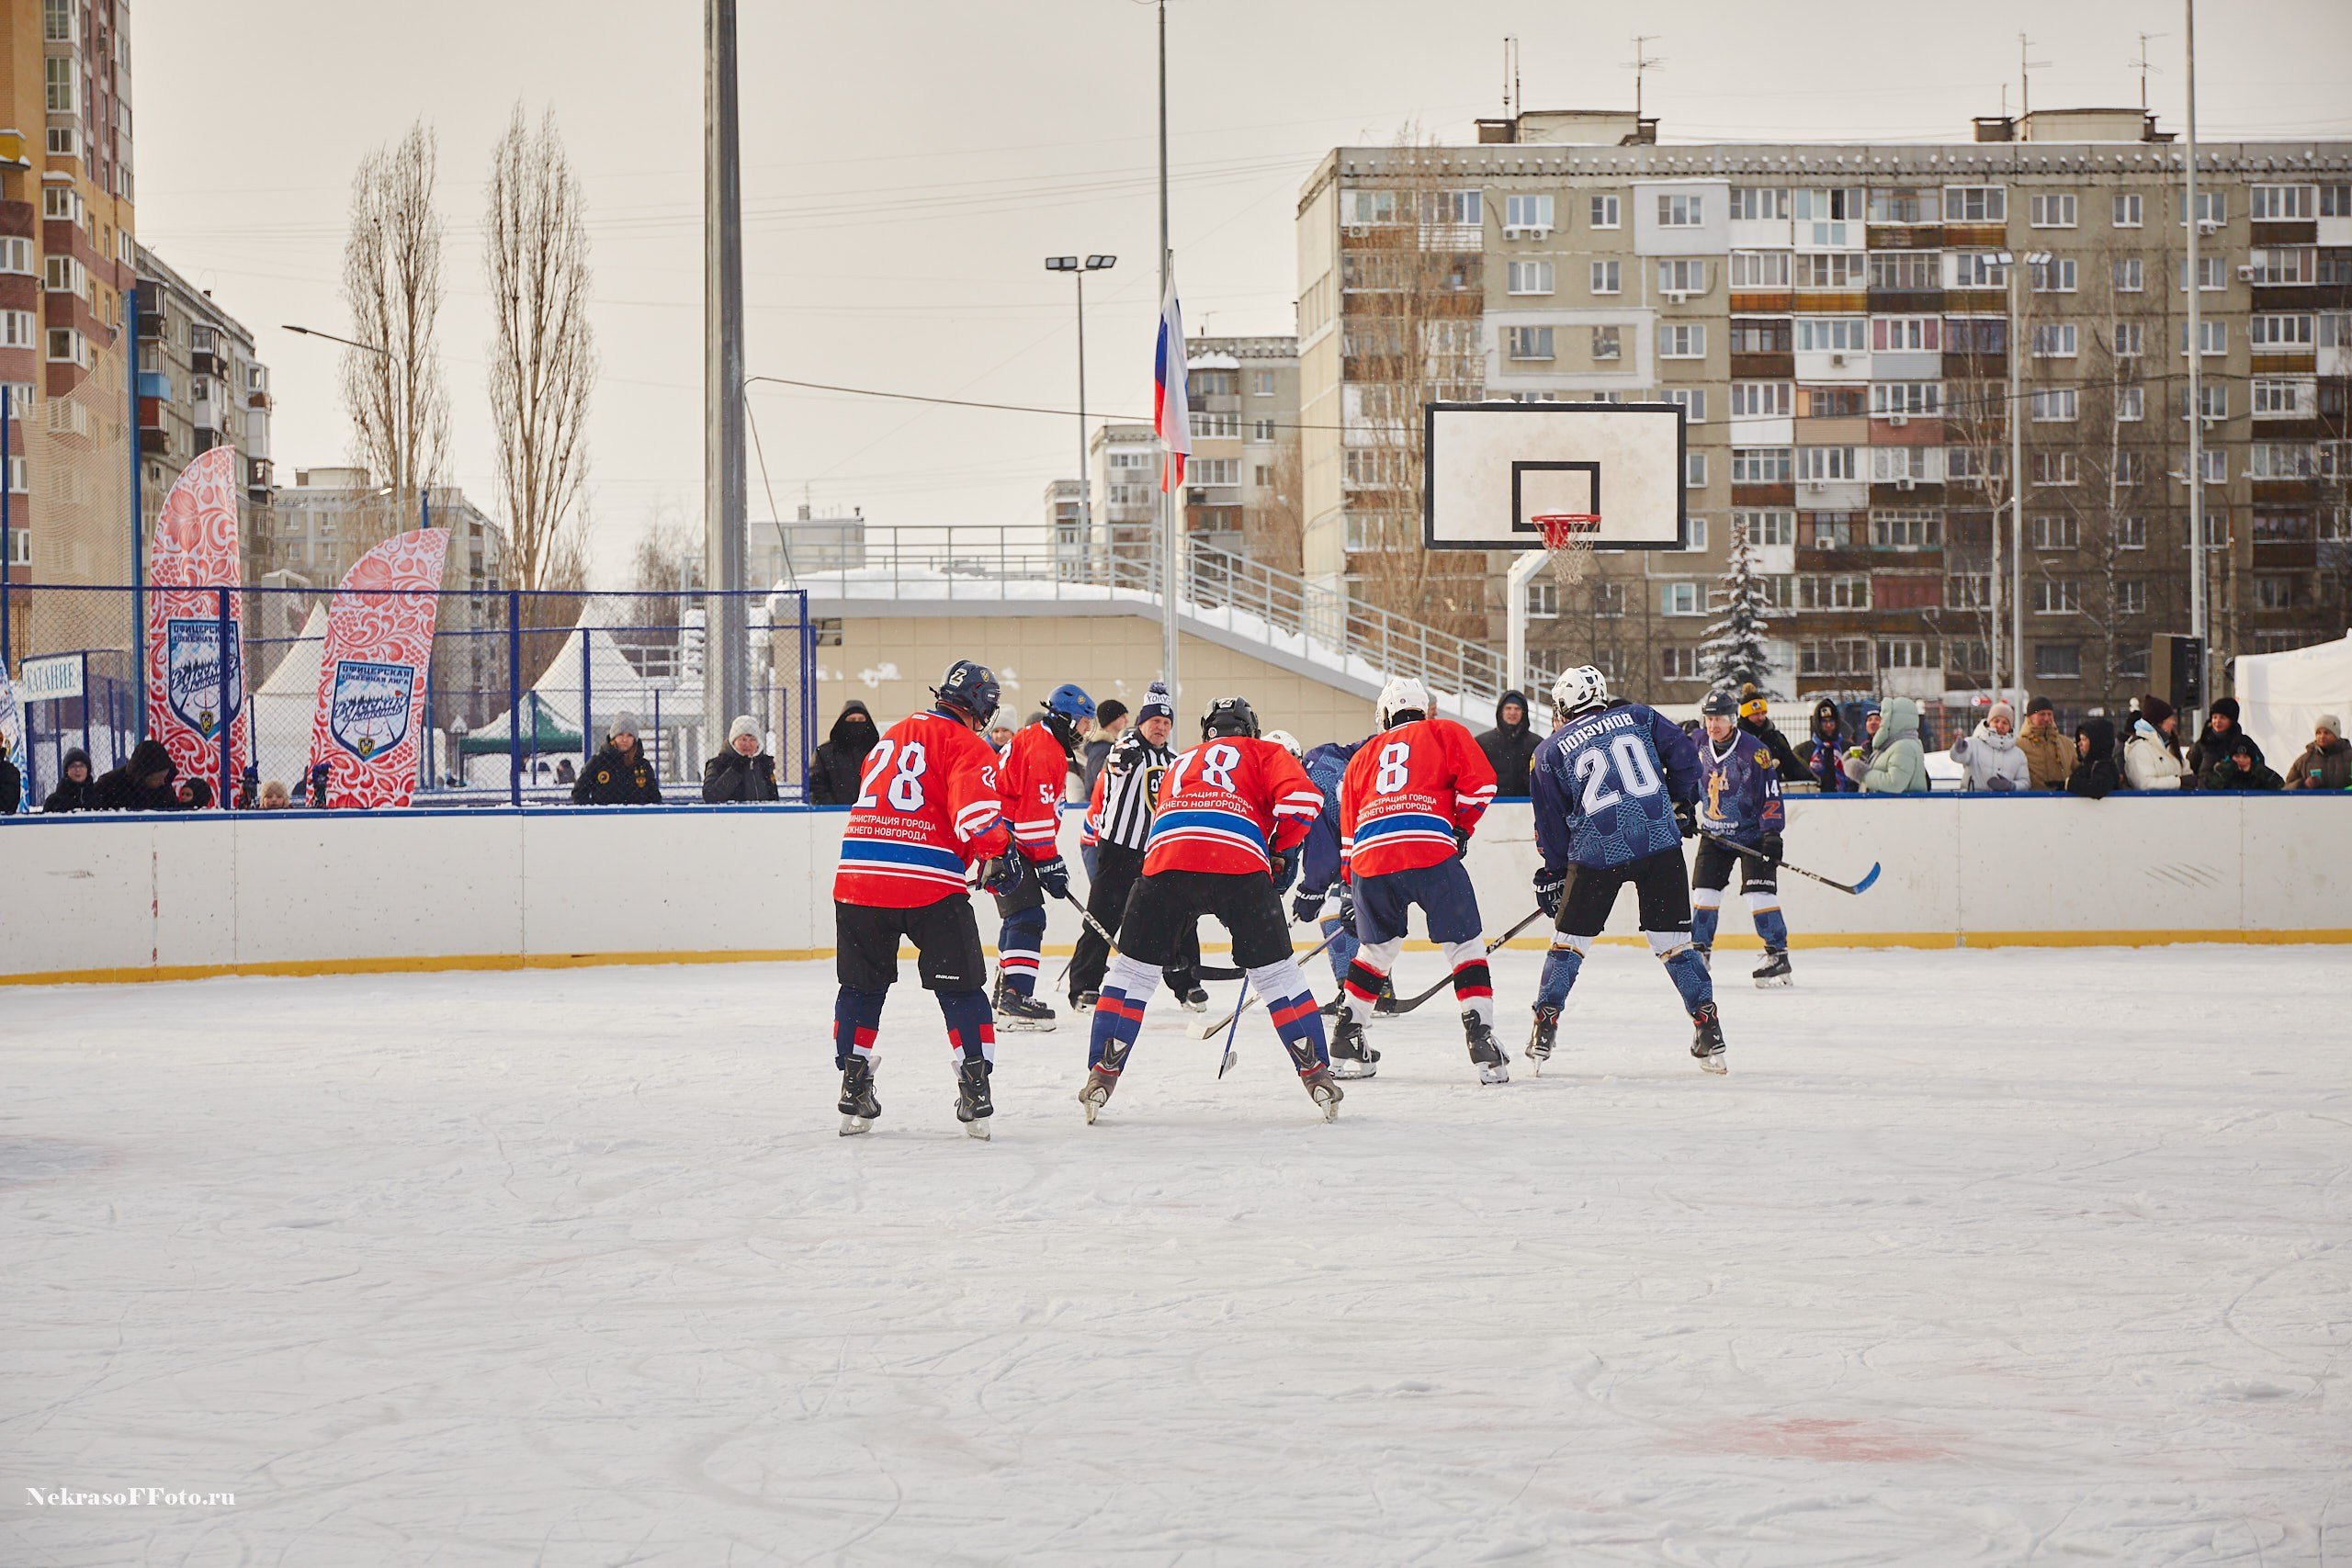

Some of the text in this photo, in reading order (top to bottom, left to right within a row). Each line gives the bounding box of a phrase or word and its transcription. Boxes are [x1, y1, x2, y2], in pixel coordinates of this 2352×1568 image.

[174, 625, 234, 634] ОФИЦЕРСКЯ
[342, 665, 410, 677] ОФИЦЕРСКАЯ
[1556, 713, 1634, 755] ПОЛЗУНОВ
[1168, 744, 1241, 797] 78
[1375, 741, 1410, 795] 8
[852, 739, 927, 812] 28
[1575, 734, 1662, 817] 20
[1385, 802, 1432, 812] НОВГОРОДА
[1408, 794, 1437, 806] ГОРОДА
[1191, 800, 1248, 815] НОВГОРОДА
[901, 818, 936, 831] ГОРОДА
[874, 827, 927, 840] НОВГОРОДА
